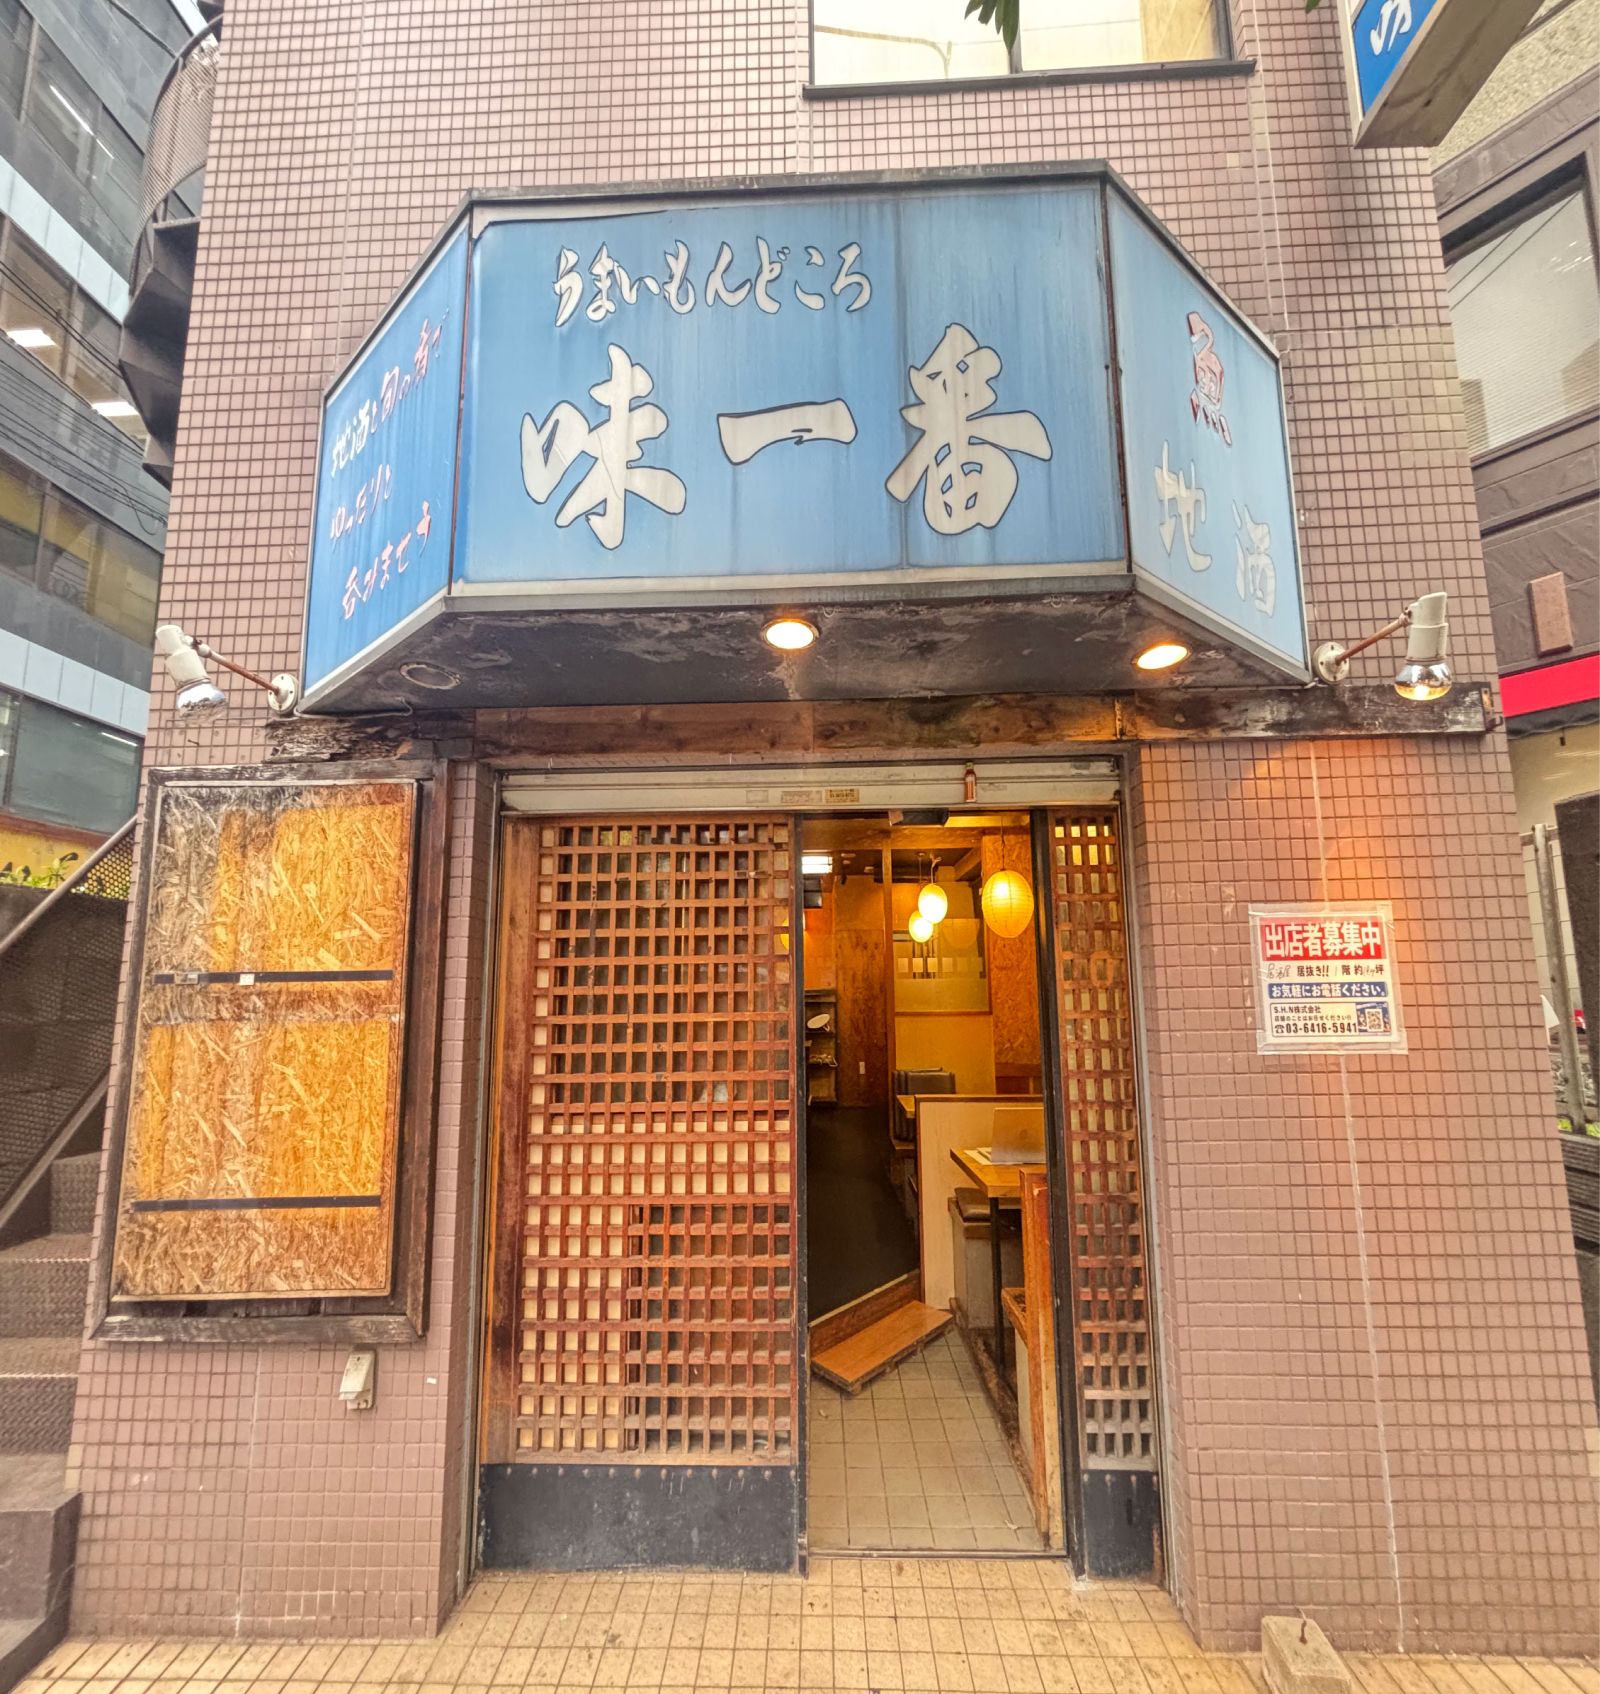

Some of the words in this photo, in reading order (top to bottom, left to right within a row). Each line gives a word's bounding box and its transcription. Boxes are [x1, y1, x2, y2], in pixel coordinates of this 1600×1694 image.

[553, 236, 872, 327] うまいもんどころ
[520, 322, 1052, 549] 味一番
[1187, 311, 1232, 447] 魚
[1154, 440, 1276, 618] 地酒
[1264, 921, 1380, 958] 出店者募集中
[1285, 1022, 1357, 1034] 03-6416-5941
